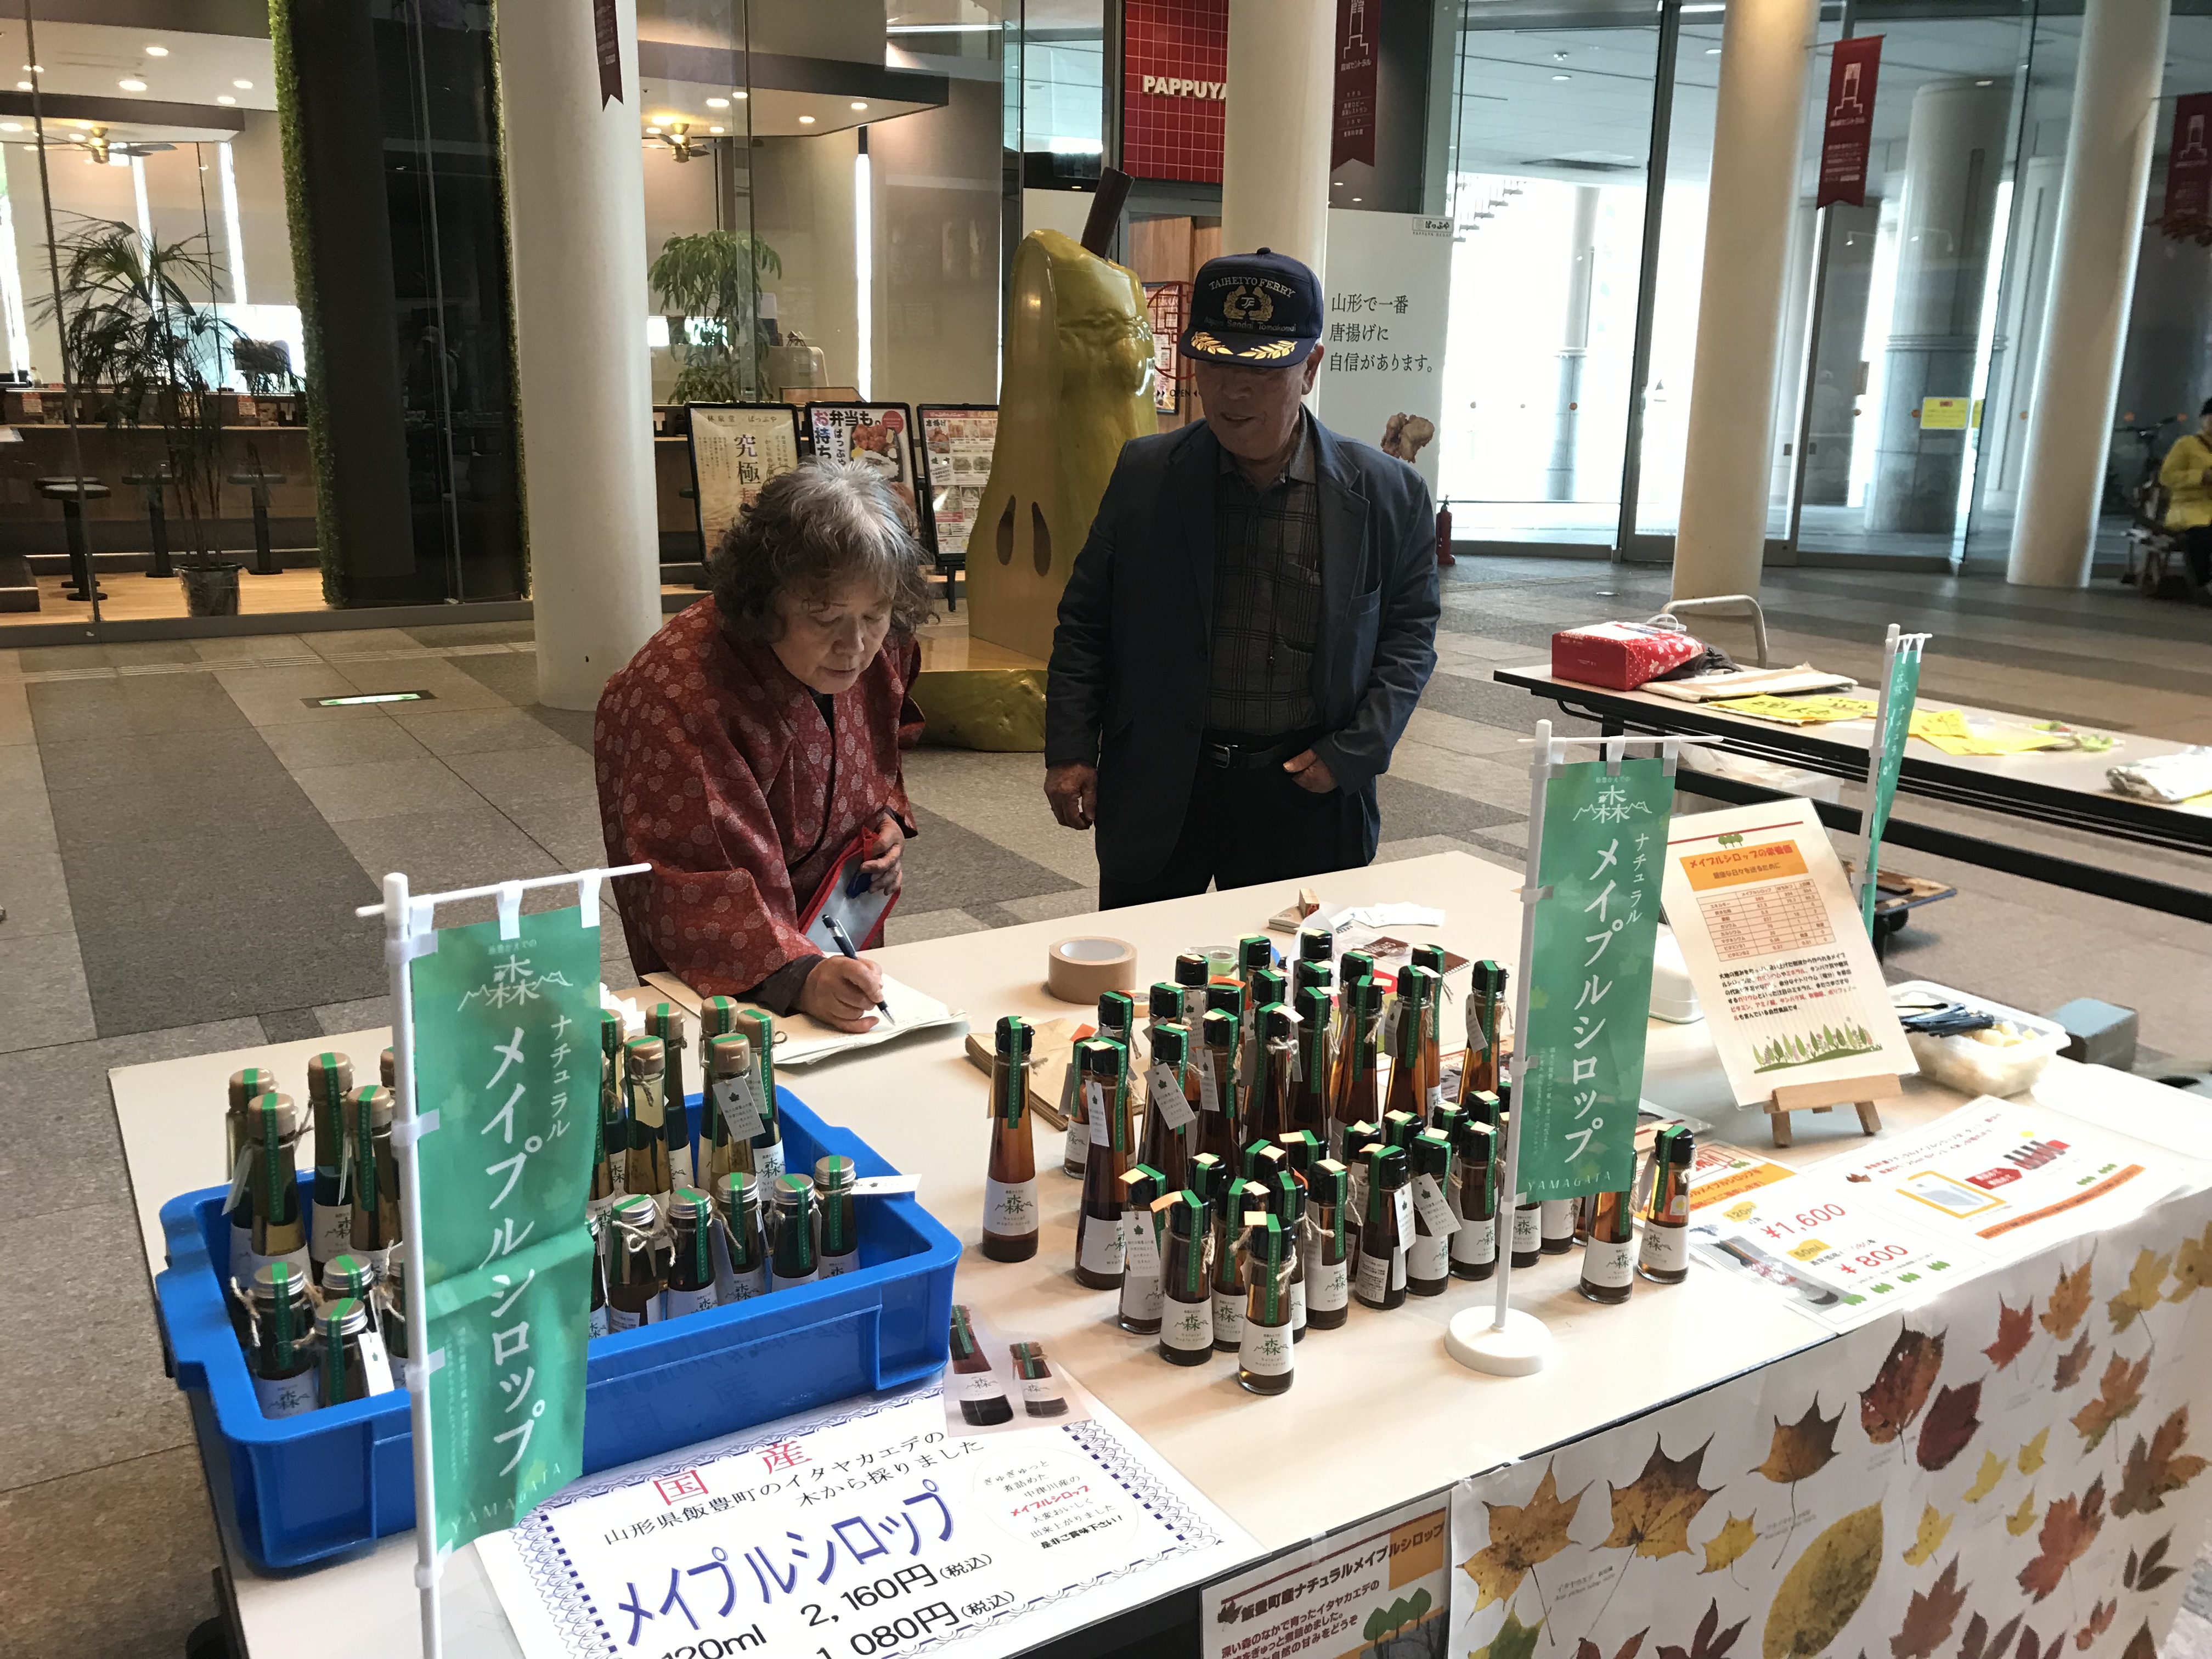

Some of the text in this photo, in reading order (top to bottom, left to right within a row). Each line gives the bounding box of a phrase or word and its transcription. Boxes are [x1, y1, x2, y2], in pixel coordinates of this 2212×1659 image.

[1209, 276, 1296, 298] TAIHEIYO FERRY
[1331, 293, 1408, 314] 山形で一番
[1227, 320, 1254, 329] Sendai
[1329, 322, 1389, 342] 唐揚げに
[1330, 352, 1433, 373] 自信があります。
[814, 410, 882, 427] お弁当も。
[1592, 785, 1630, 823] 森
[1626, 833, 1649, 925] ナチュラル
[486, 955, 539, 1008] 森
[1565, 838, 1624, 1164] メイプルシロップ
[546, 1015, 573, 1142] ナチュラル
[1527, 1171, 1611, 1192] YAMAGATA
[1003, 1194, 1024, 1214] 森
[1760, 1204, 1846, 1239] ¥1,600
[478, 1026, 545, 1477] メイプルシロップ
[1855, 1245, 1908, 1267] 800
[1183, 1314, 1200, 1331] 森
[1262, 1338, 1280, 1356] 森
[797, 1440, 984, 1507] 木から採りました
[983, 1460, 1050, 1486] ぎゅぎゅっと
[1003, 1474, 1050, 1493] 煮詰めた
[1024, 1476, 1080, 1498] 中津川産の
[451, 1463, 561, 1534] YAMAGATA
[603, 1431, 945, 1545] 山形県飯豊町のイタヤカエデの
[1010, 1485, 1091, 1517] メイプルシロップ
[1030, 1505, 1116, 1538] 出来上がりました
[1033, 1498, 1094, 1523] 大変おいしく
[618, 1479, 955, 1647] メイプルシロップ
[1241, 1521, 1446, 1623] 飯豊町産ナチュラルメイプルシロップ
[1221, 1579, 1380, 1658] 深い森のなかで育ったイタヤカエデの
